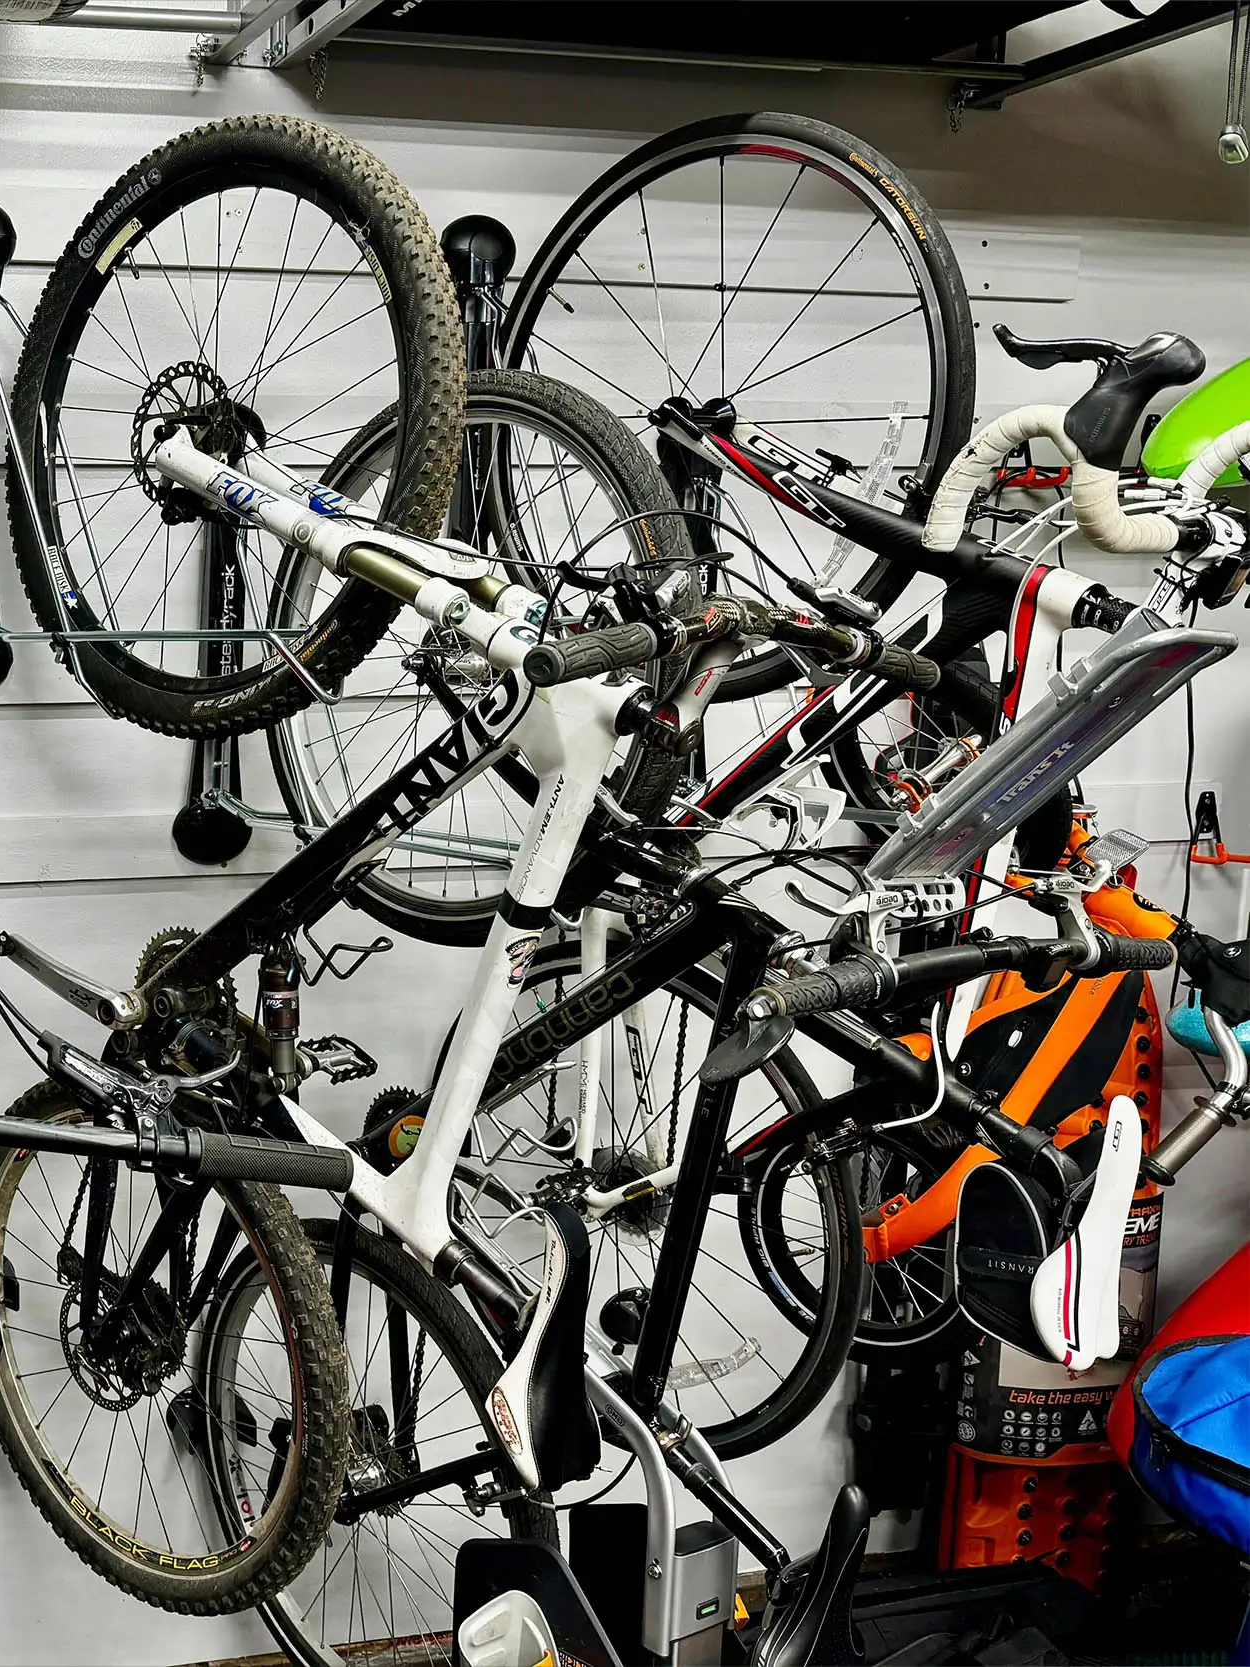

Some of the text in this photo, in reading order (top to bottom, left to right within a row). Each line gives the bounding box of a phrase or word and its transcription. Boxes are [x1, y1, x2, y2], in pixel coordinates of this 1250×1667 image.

[78, 175, 151, 258] Continental
[879, 178, 927, 240] GATORSKIN
[492, 971, 634, 1084] cannond
[987, 1259, 1034, 1275] RANSIT
[1009, 1389, 1046, 1405] take
[1048, 1391, 1071, 1405] the
[1073, 1390, 1103, 1405] easy
[69, 1496, 149, 1561] BLACK
[159, 1555, 219, 1570] FLAG
